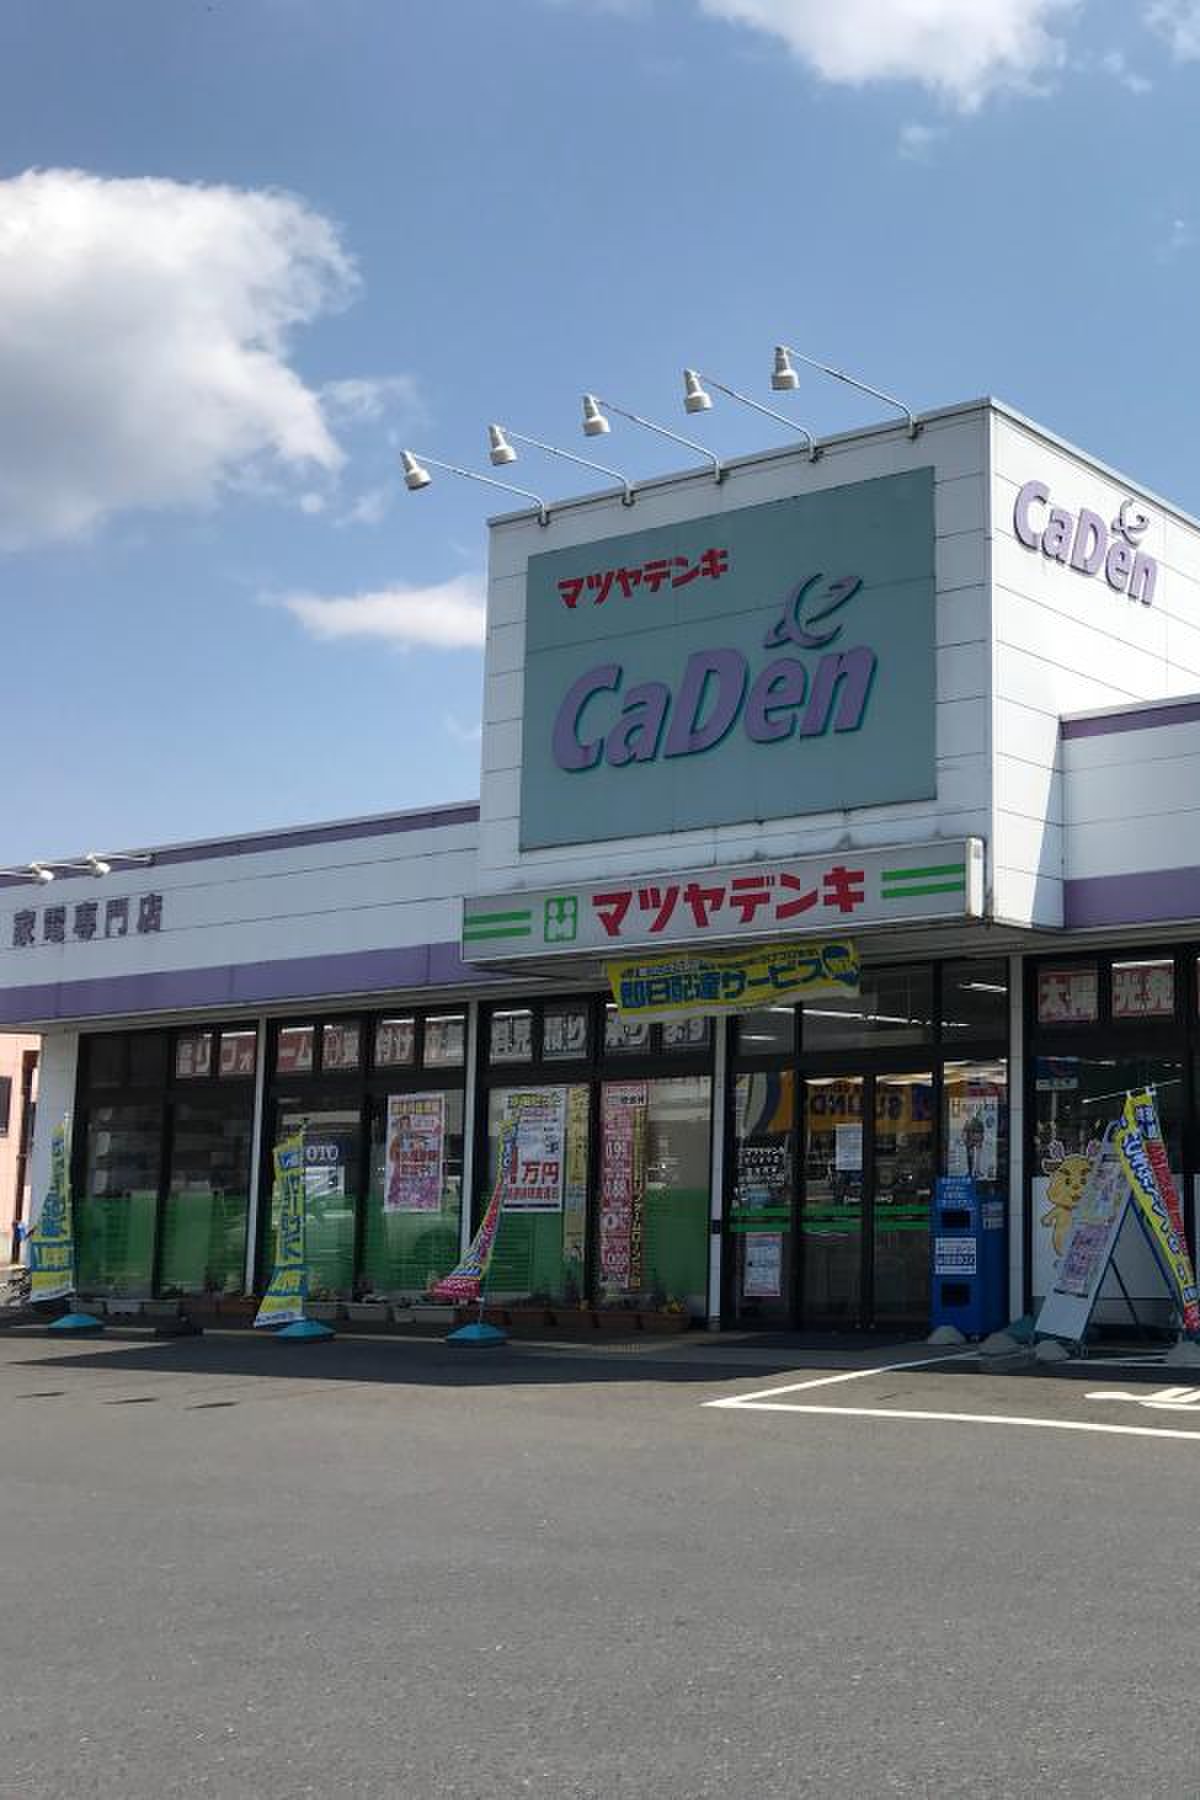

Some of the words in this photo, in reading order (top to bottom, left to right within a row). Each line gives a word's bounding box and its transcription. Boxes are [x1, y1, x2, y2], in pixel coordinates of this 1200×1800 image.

[557, 548, 729, 609] マツヤデンキ
[1012, 479, 1160, 607] CaDen
[552, 645, 879, 773] CaDen
[12, 893, 164, 947] 家電専門店
[592, 866, 866, 937] マツヤデンキ
